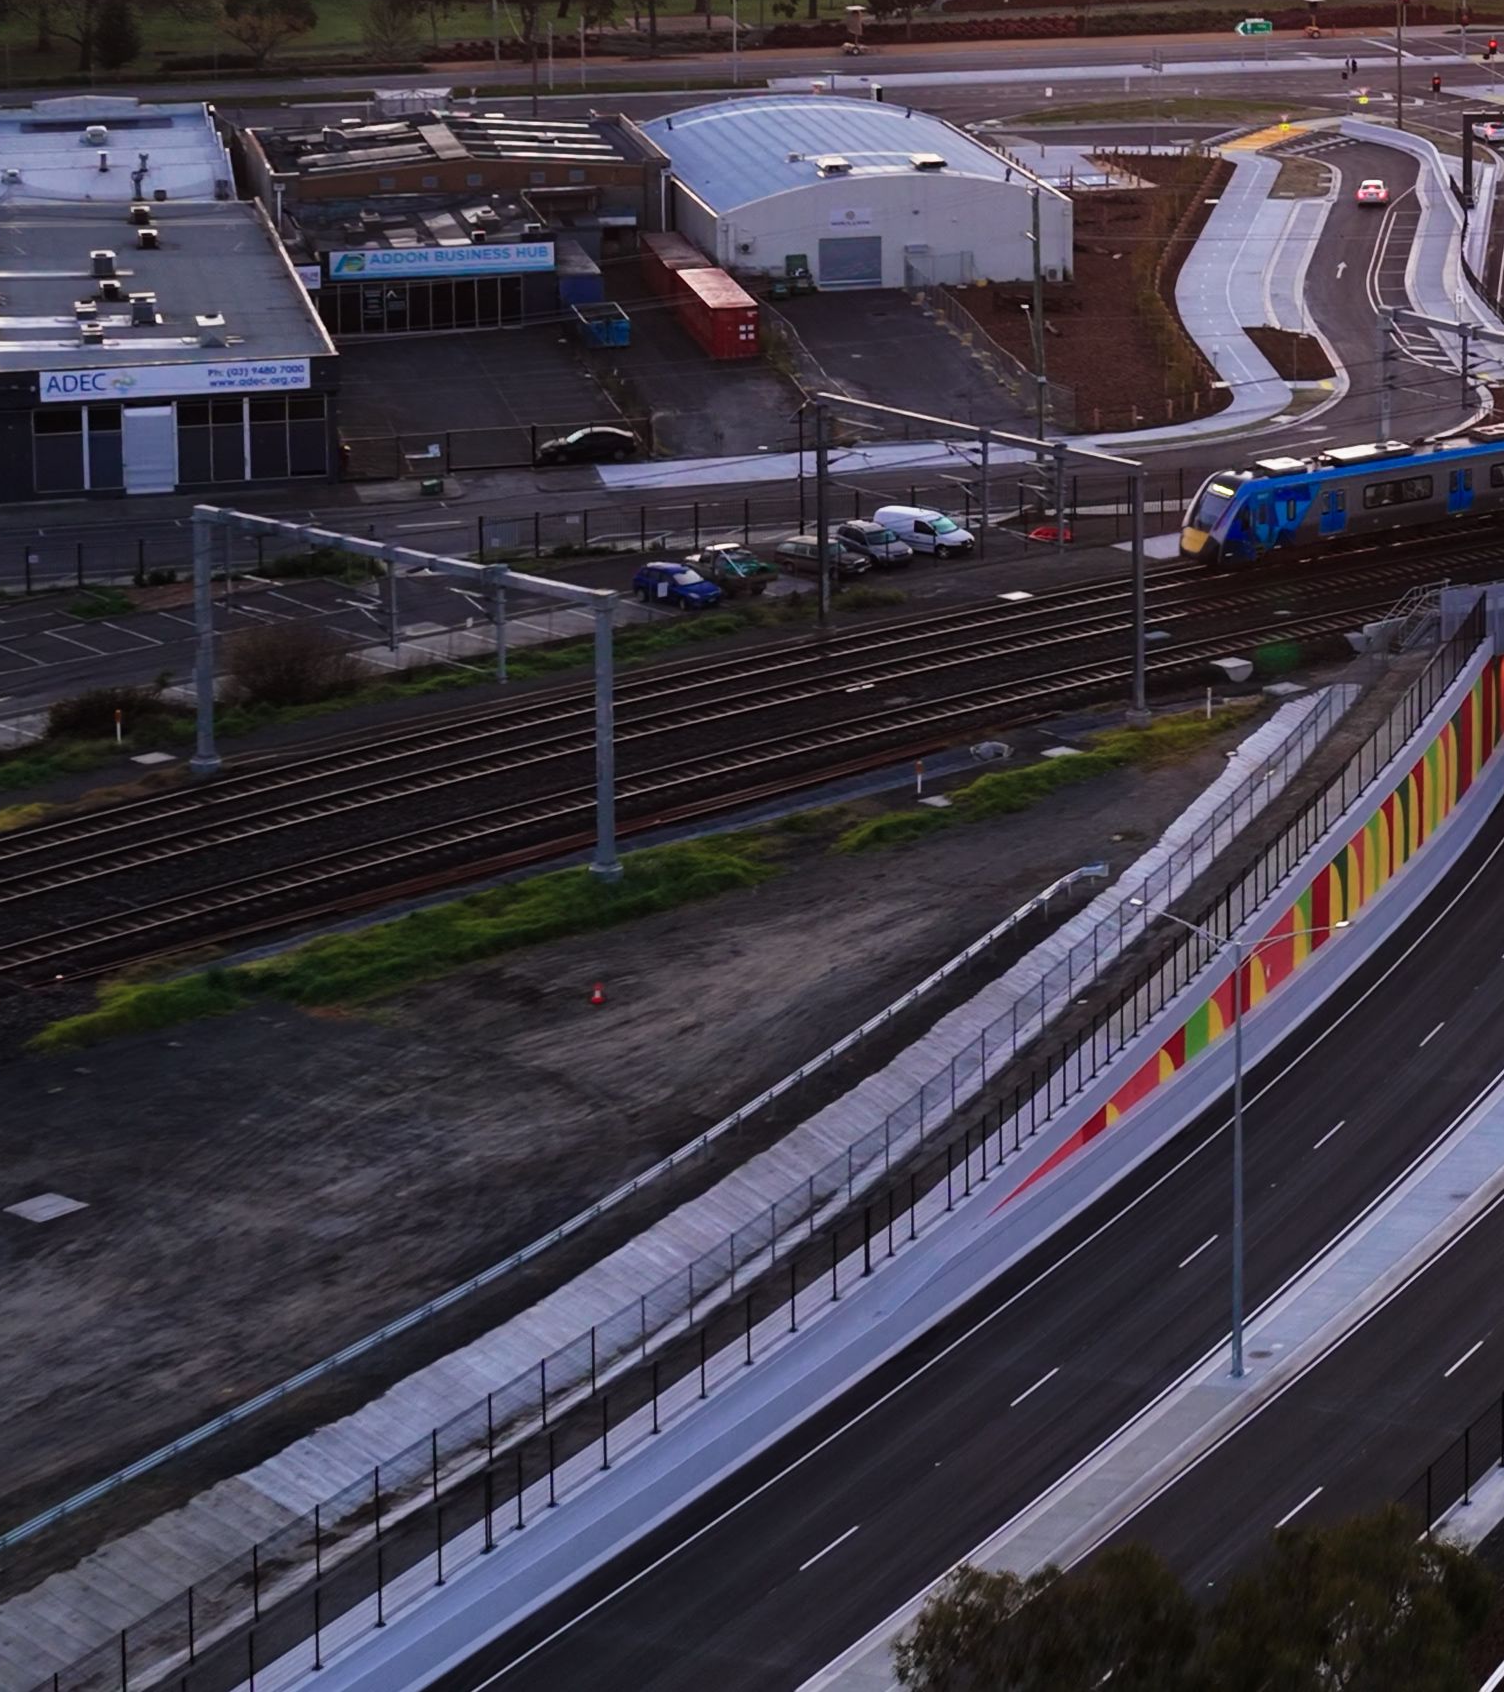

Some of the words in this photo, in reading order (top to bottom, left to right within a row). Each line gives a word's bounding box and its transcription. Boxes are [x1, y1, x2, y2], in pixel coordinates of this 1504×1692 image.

[370, 252, 429, 264] ADDON
[434, 246, 512, 261] BUSINESS
[516, 246, 549, 258] HUB
[226, 368, 248, 378] (03)
[46, 373, 108, 393] ADEC
